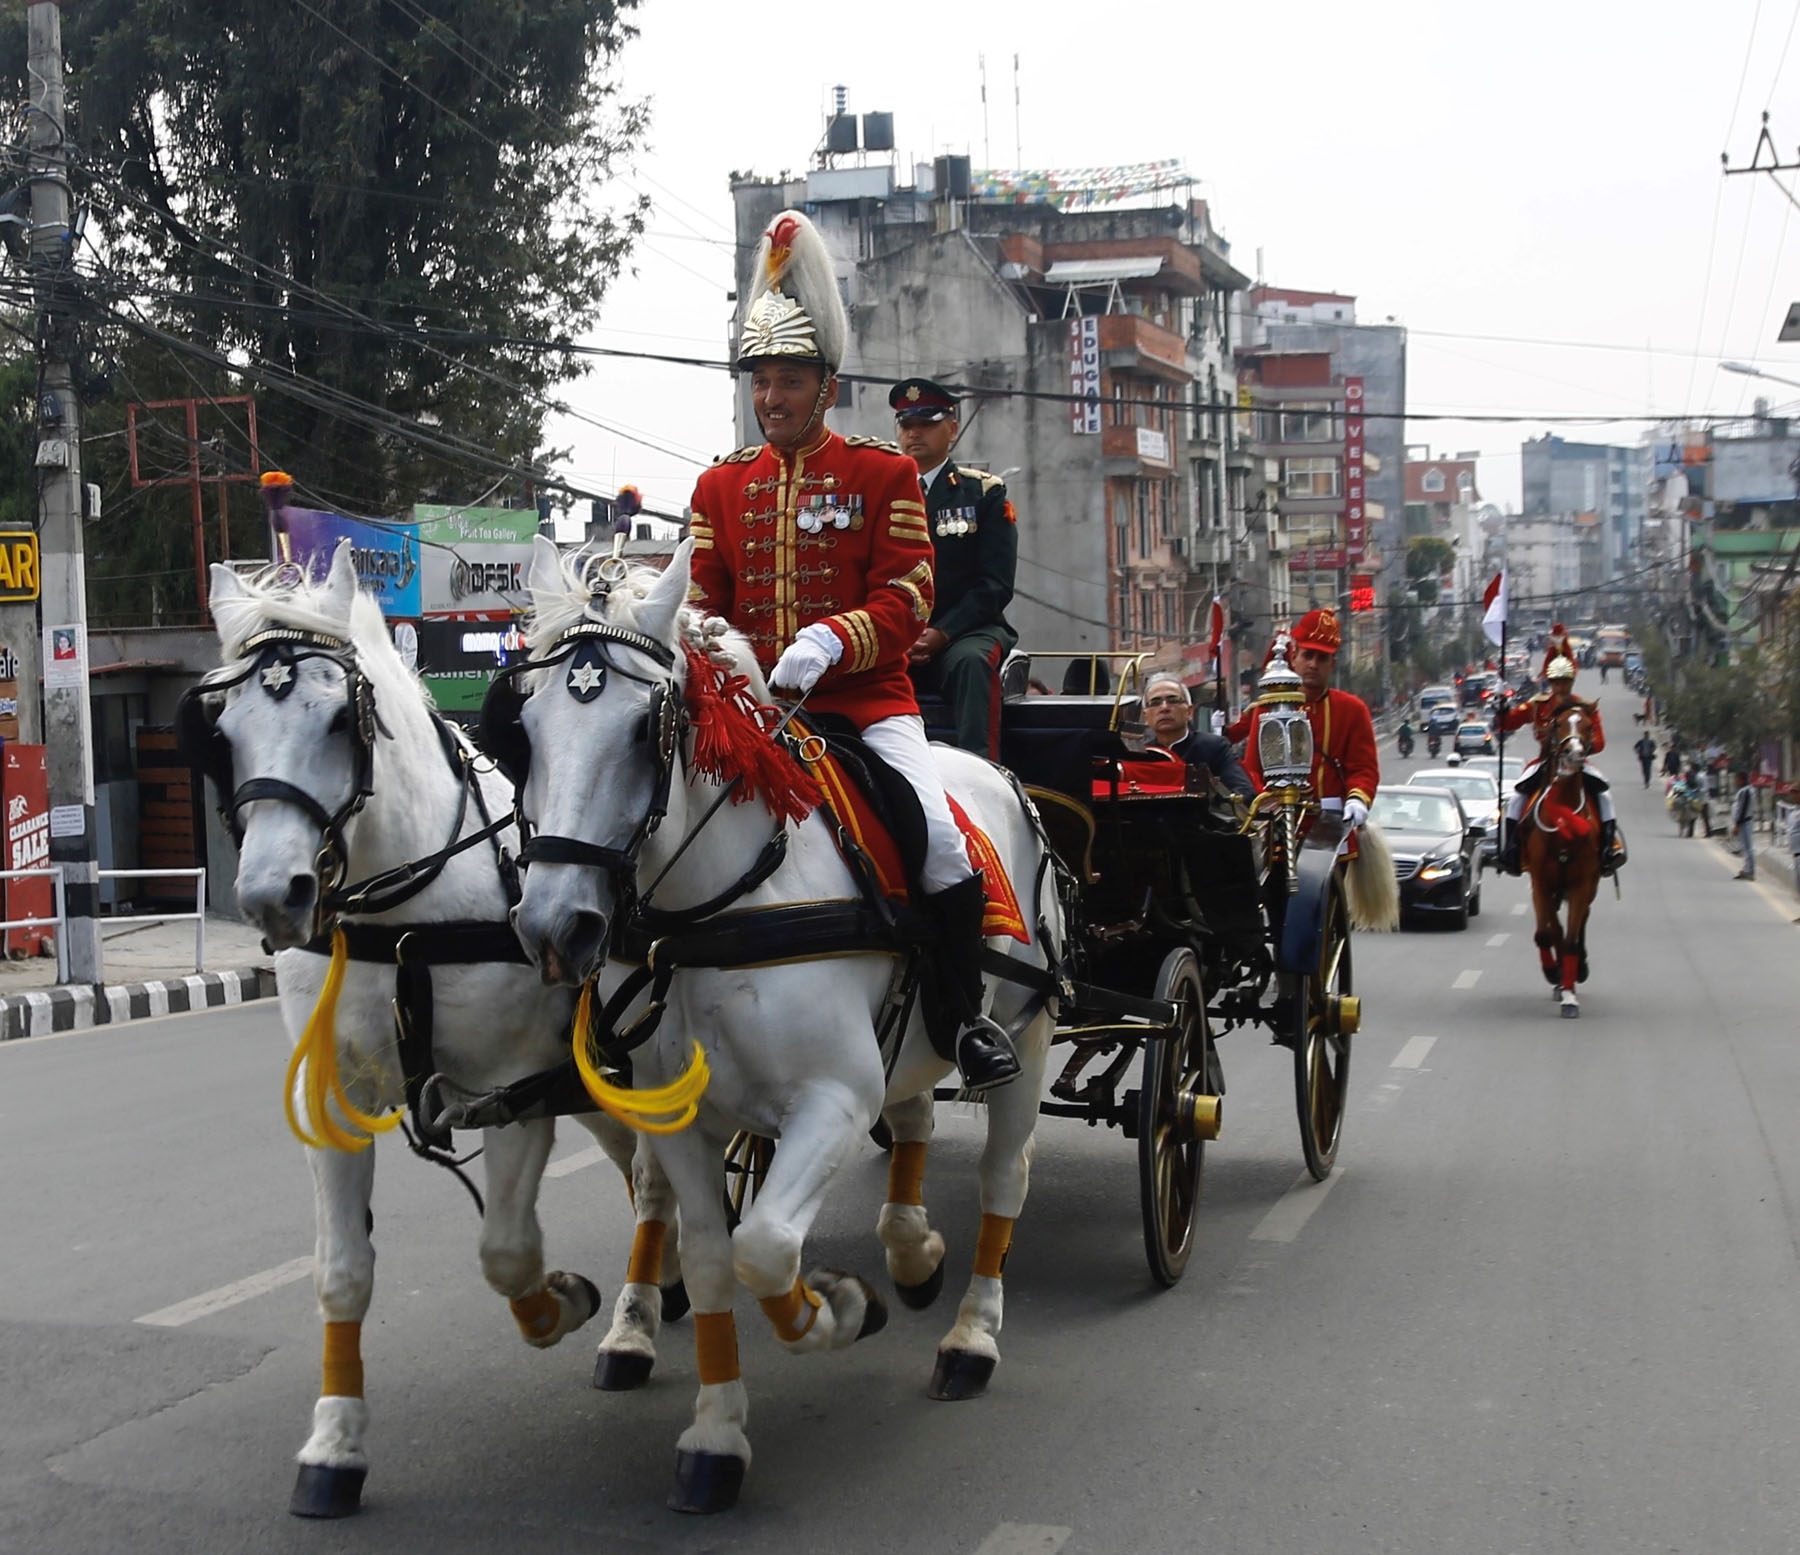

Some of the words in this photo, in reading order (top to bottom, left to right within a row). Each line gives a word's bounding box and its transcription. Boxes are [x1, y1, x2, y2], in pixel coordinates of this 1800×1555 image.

[1071, 321, 1083, 433] SIMRIK
[1084, 320, 1098, 432] EDUGATE
[479, 527, 491, 539] Tea
[493, 527, 517, 542] Gallery
[12, 827, 49, 870] SALE
